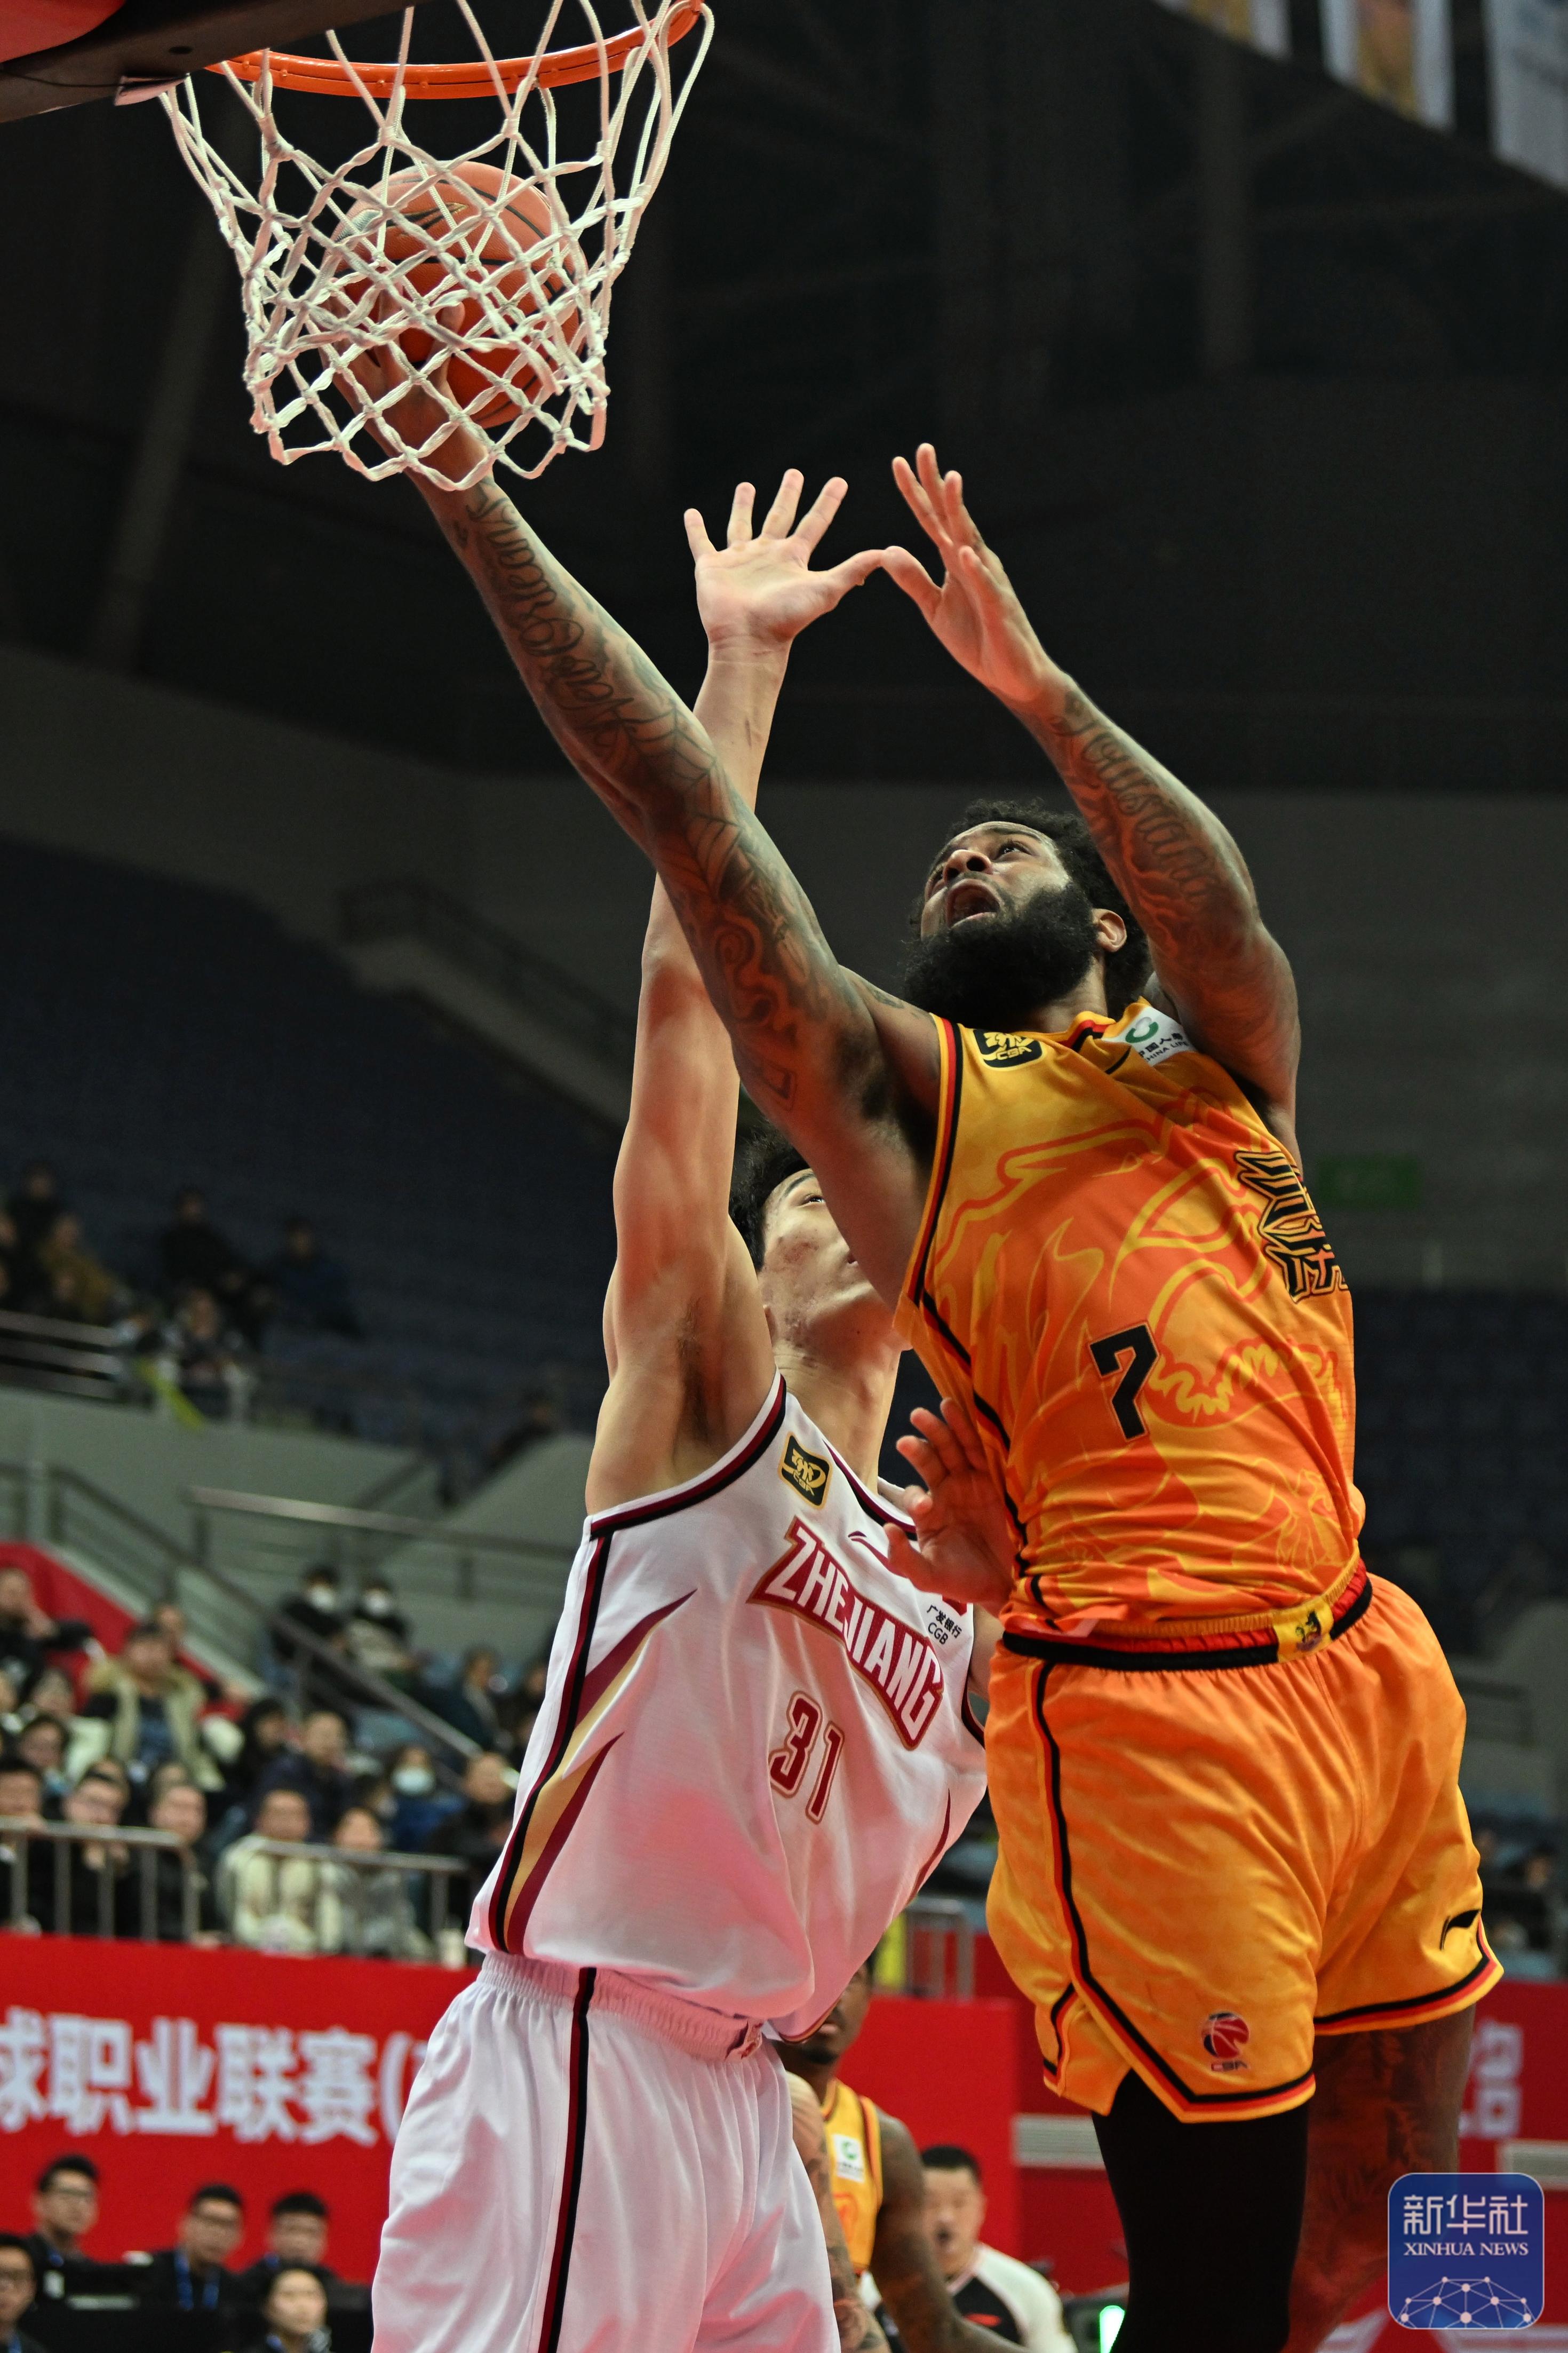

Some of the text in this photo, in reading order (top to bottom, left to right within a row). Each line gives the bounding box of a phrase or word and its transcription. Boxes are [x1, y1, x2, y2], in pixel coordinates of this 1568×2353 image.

[1145, 1047, 1169, 1063] HINA
[1089, 1324, 1159, 1441] 7
[763, 1522, 943, 1744] ZHEJIANG
[926, 1604, 962, 1639] 广发银行
[928, 1621, 949, 1645] CGB
[769, 1692, 843, 1823] 31
[0, 2005, 428, 2147] 球职业联赛(
